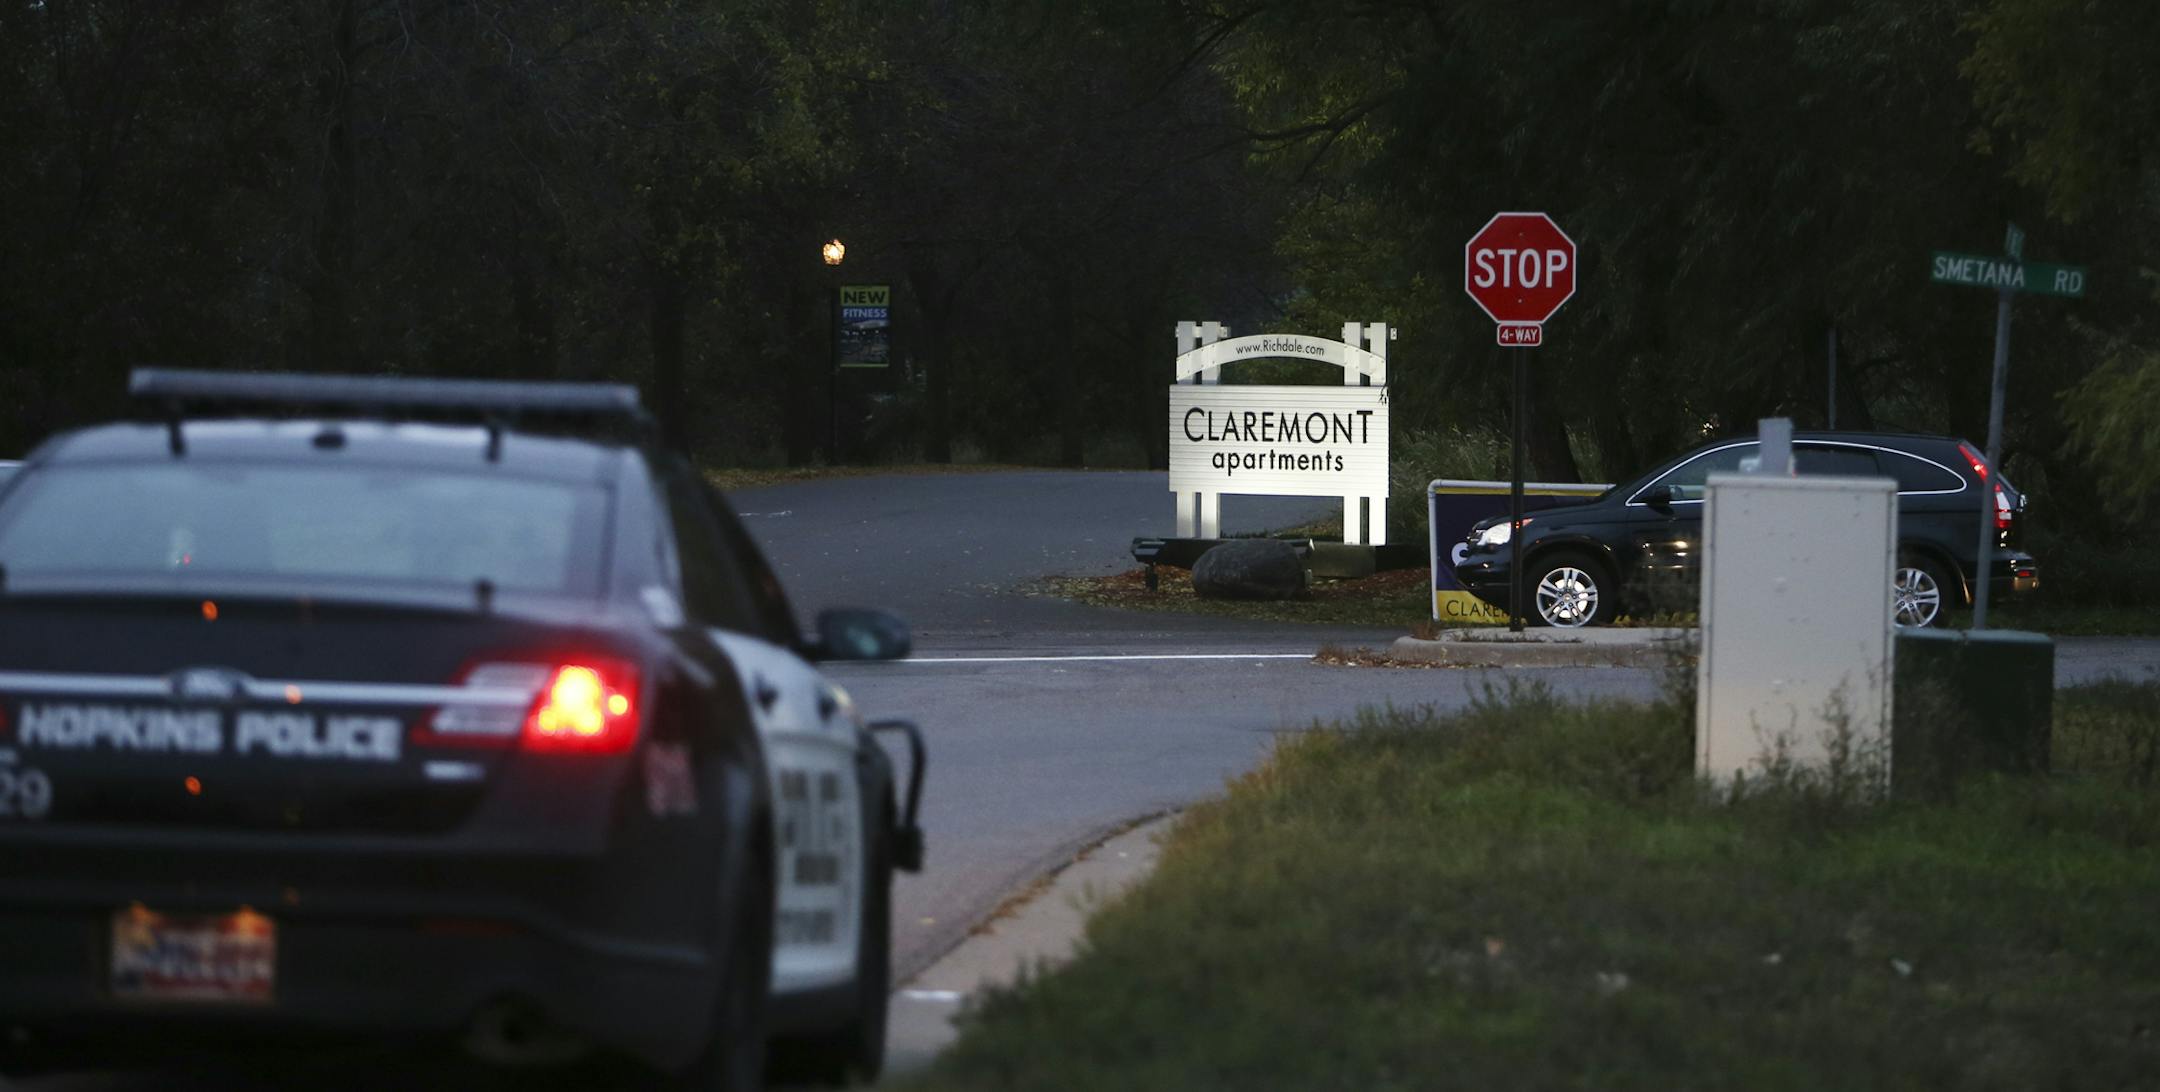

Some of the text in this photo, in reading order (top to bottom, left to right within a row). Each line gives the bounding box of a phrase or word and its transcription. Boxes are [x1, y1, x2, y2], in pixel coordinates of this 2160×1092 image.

[1474, 248, 1568, 288] STOP
[1934, 256, 2083, 293] SMETANA RD
[844, 291, 885, 303] NEW
[843, 308, 887, 318] FITNESS
[1235, 338, 1325, 355] www.Richdale.com
[1501, 328, 1538, 341] 4-WAY
[1184, 407, 1373, 444] CLAREMONT
[1212, 449, 1344, 476] apartments
[17, 704, 401, 760] HOPKINS POLICE
